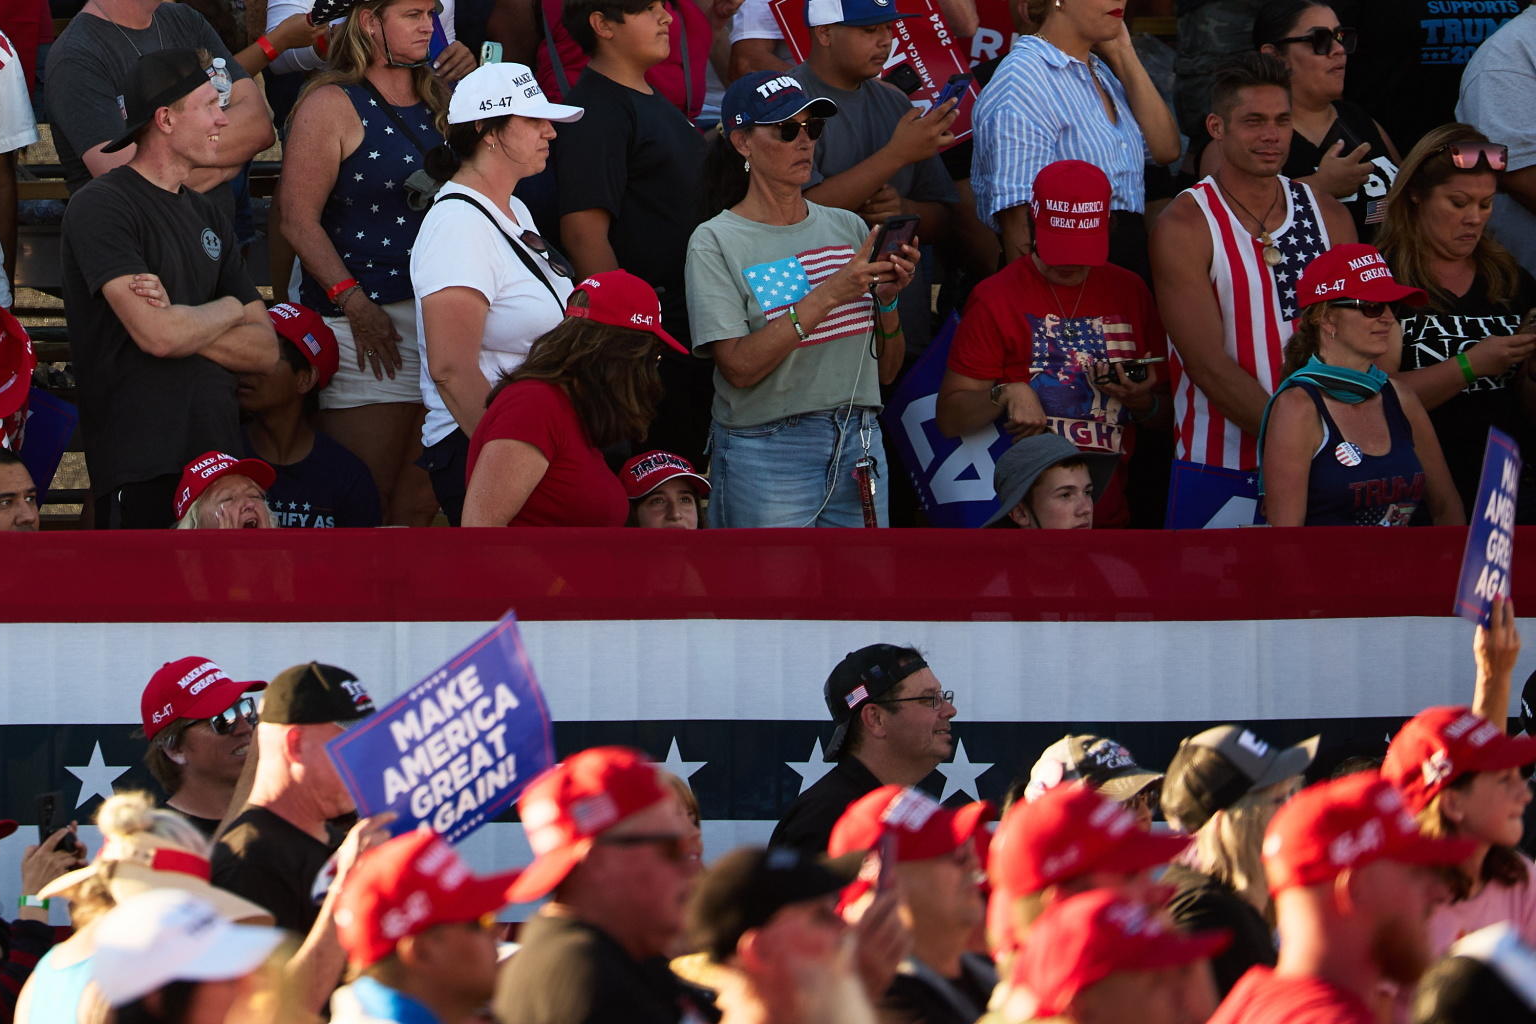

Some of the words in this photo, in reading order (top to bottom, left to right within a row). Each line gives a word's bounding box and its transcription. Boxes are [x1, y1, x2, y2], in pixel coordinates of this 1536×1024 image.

[1425, 0, 1521, 15] SUPPORTS
[928, 12, 953, 47] 2024
[906, 41, 936, 90] AMERICA
[512, 71, 534, 89] MAKE
[478, 95, 514, 113] 45-47
[1046, 198, 1070, 213] MAKE
[1070, 200, 1104, 215] AMERICA
[1049, 215, 1076, 229] GREAT
[1076, 216, 1101, 229] AGAIN
[1347, 255, 1375, 272] MAKE
[1359, 267, 1386, 283] GREAT
[1314, 278, 1347, 296] 45-47
[630, 312, 654, 326] 45-47
[189, 455, 216, 474] MAKE
[151, 702, 175, 724] 45-47
[390, 664, 485, 754] MAKE
[383, 682, 520, 806] AMERICA
[410, 723, 508, 819] GREAT
